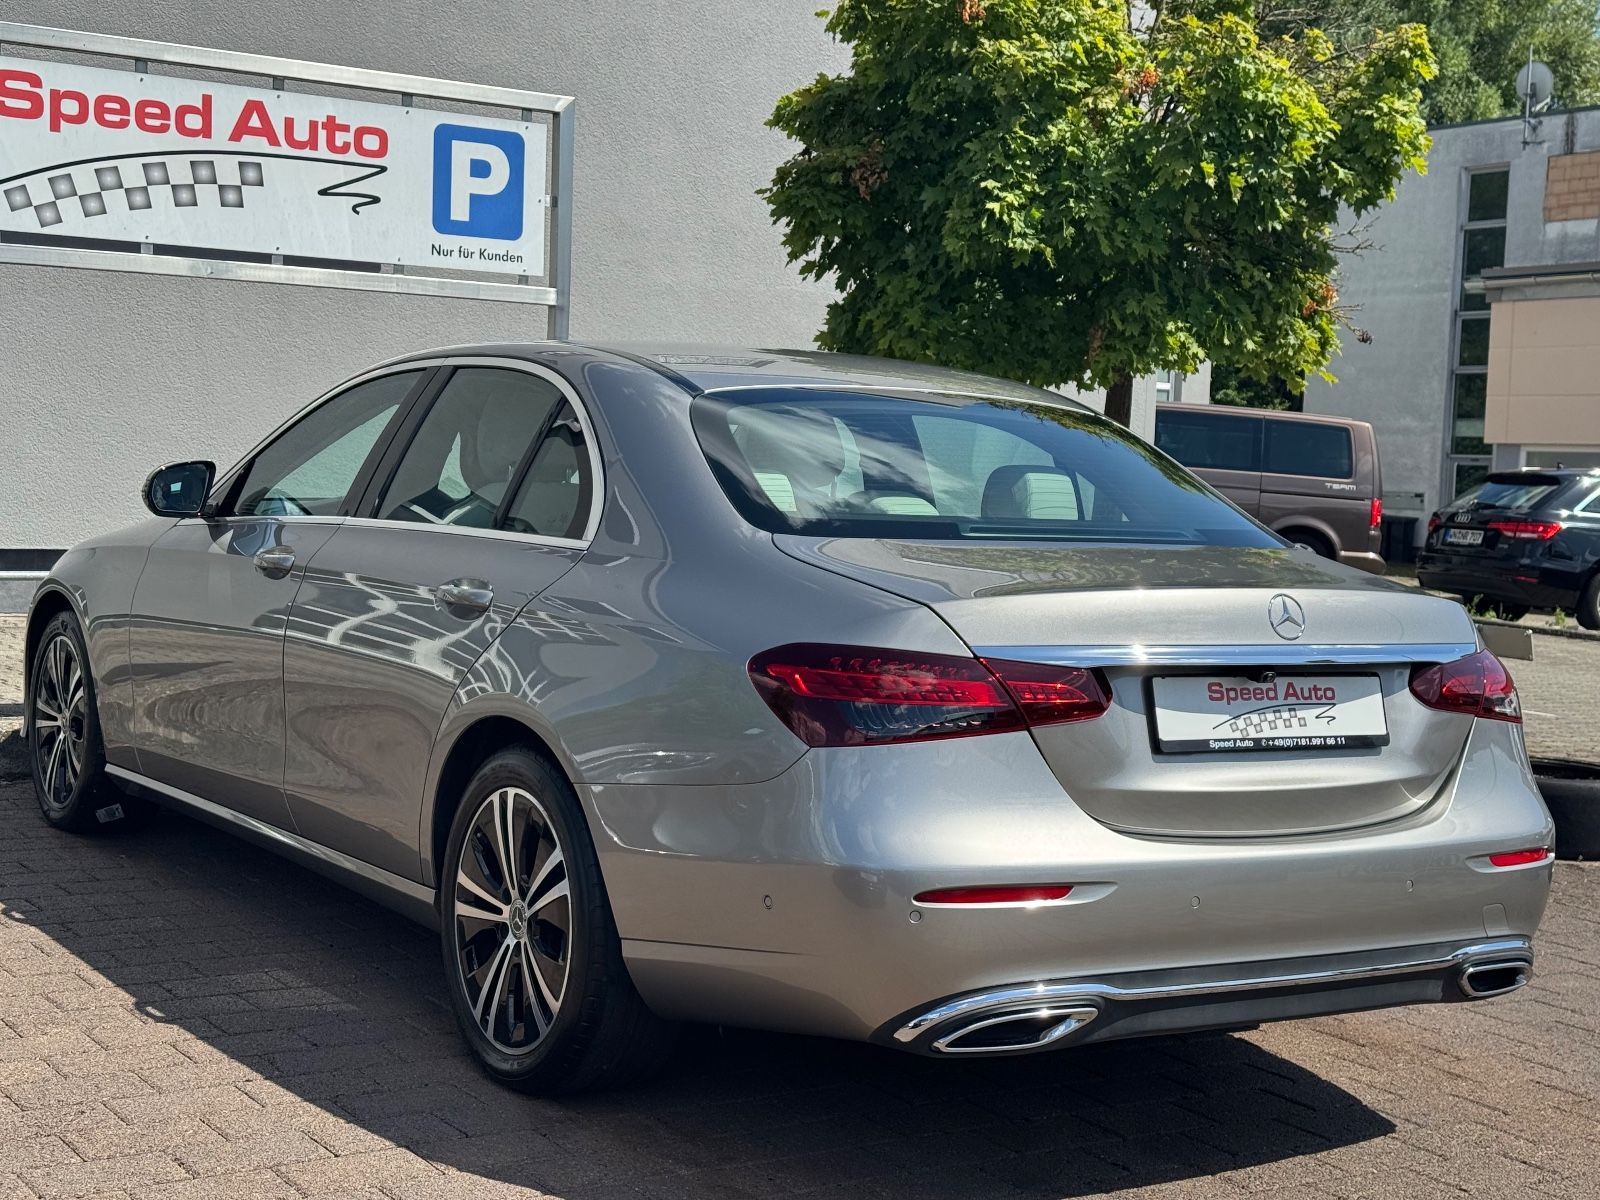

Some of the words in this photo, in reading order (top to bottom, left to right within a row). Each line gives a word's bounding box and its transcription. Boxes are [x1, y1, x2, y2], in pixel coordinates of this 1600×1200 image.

[0, 69, 212, 139] Speed
[228, 99, 389, 159] Auto
[450, 140, 510, 222] P
[431, 243, 454, 257] Nur
[458, 245, 475, 259] für
[479, 248, 523, 263] Kunden
[1325, 482, 1357, 491] TEAM
[1207, 681, 1279, 705] Speed
[1283, 681, 1336, 701] Auto
[1209, 740, 1235, 750] Speed
[1235, 739, 1254, 748] Auto
[1337, 737, 1346, 745] 11
